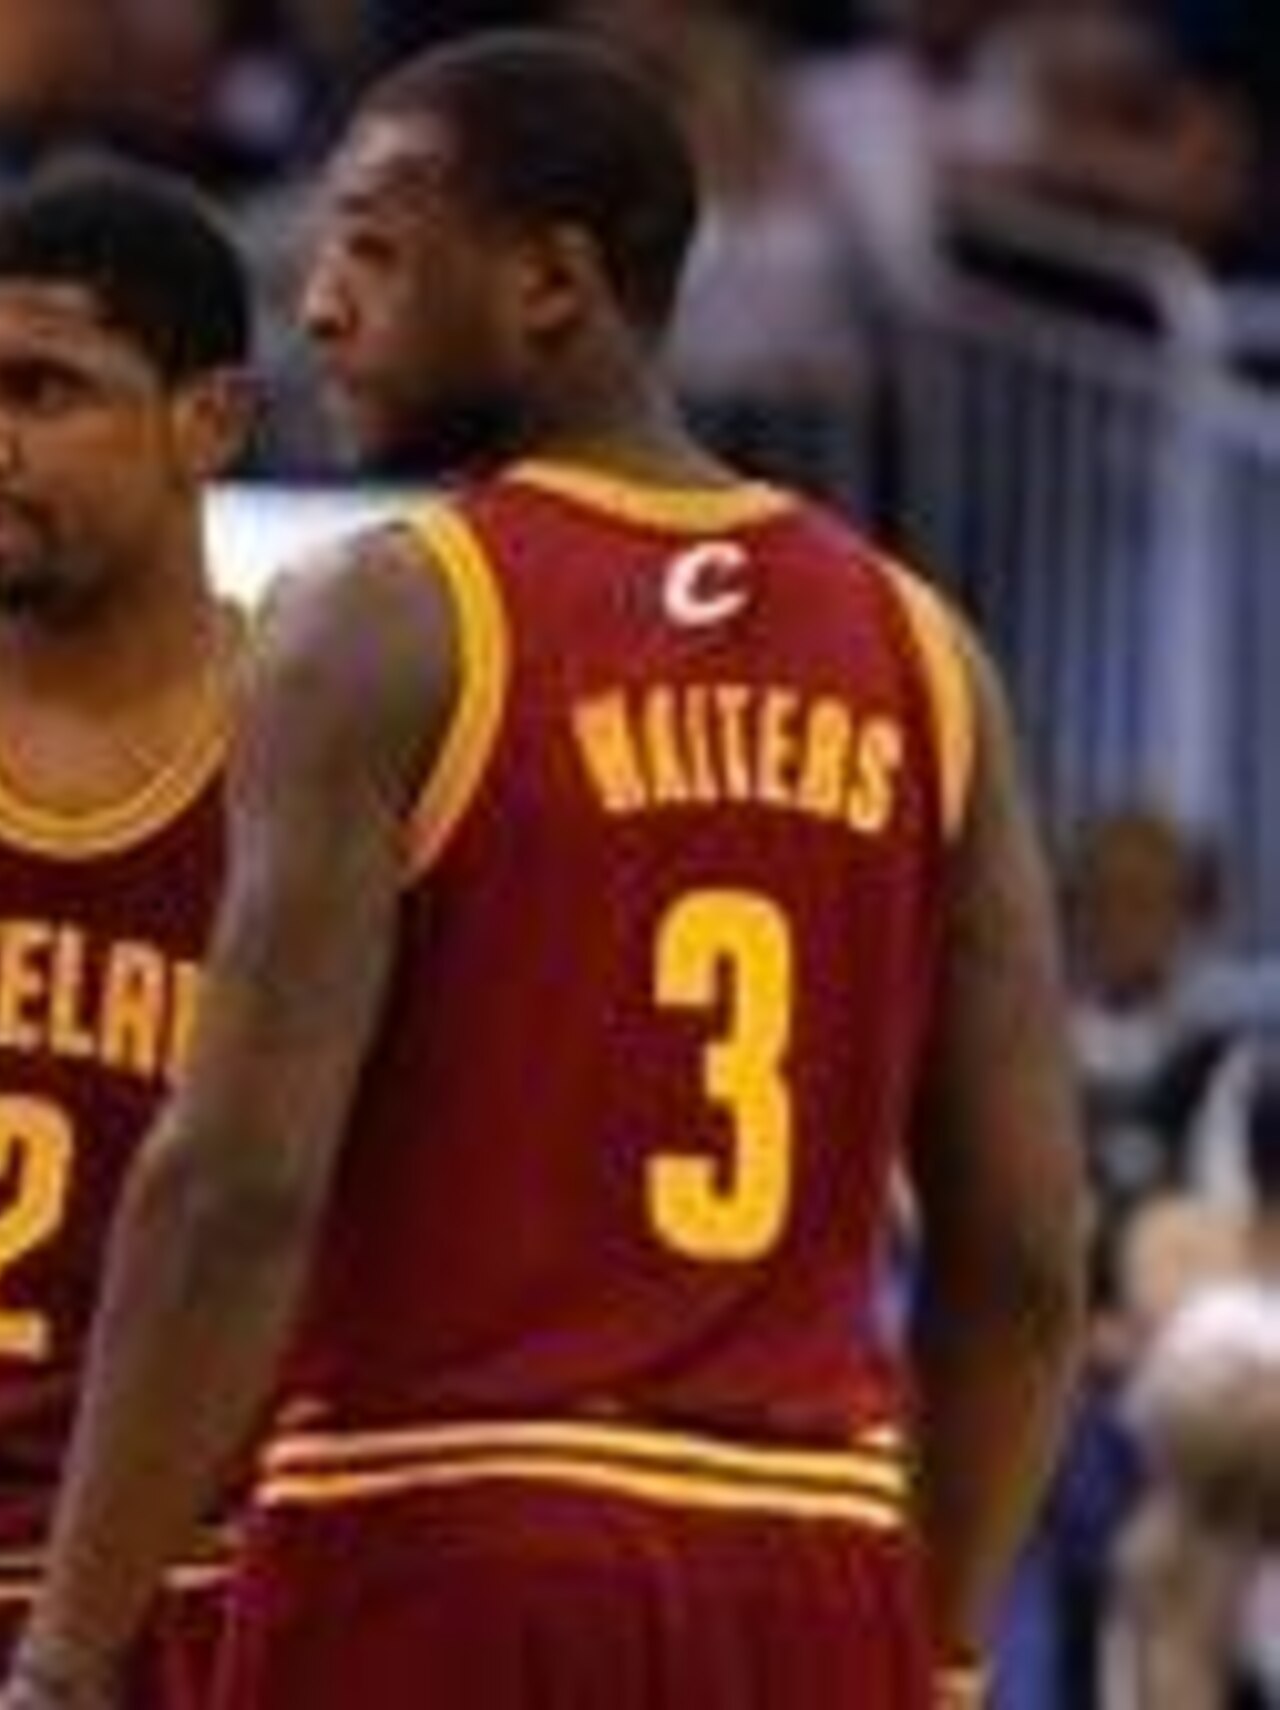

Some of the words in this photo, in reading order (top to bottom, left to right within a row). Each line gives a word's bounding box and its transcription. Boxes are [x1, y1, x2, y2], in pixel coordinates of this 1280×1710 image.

[663, 541, 750, 625] C
[572, 684, 904, 833] WAITERS
[647, 888, 791, 1260] 3
